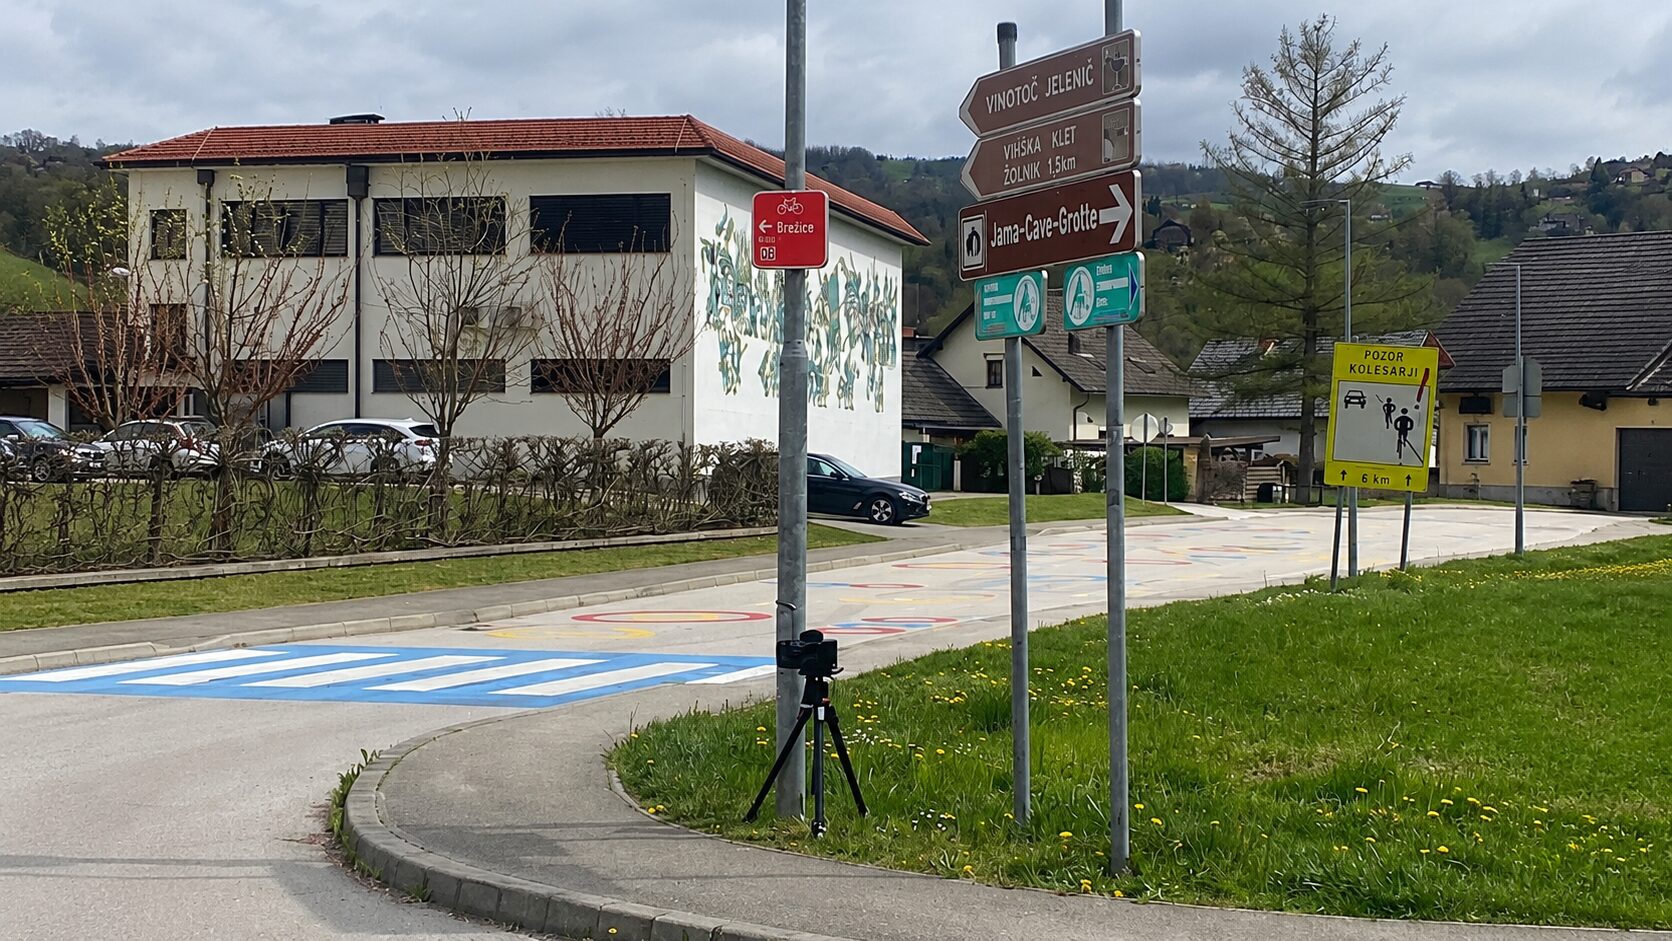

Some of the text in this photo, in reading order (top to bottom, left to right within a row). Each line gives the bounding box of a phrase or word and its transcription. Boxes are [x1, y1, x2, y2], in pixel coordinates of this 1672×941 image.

[985, 58, 1094, 114] VINOTOČ JELENIČ
[1051, 125, 1077, 149] KLET
[777, 221, 814, 233] Brežice
[990, 202, 1098, 248] Jama-Cave-Grotte
[1364, 350, 1404, 362] POZOR
[1349, 363, 1418, 377] KOLESARJI
[1361, 473, 1390, 485] 6 km
